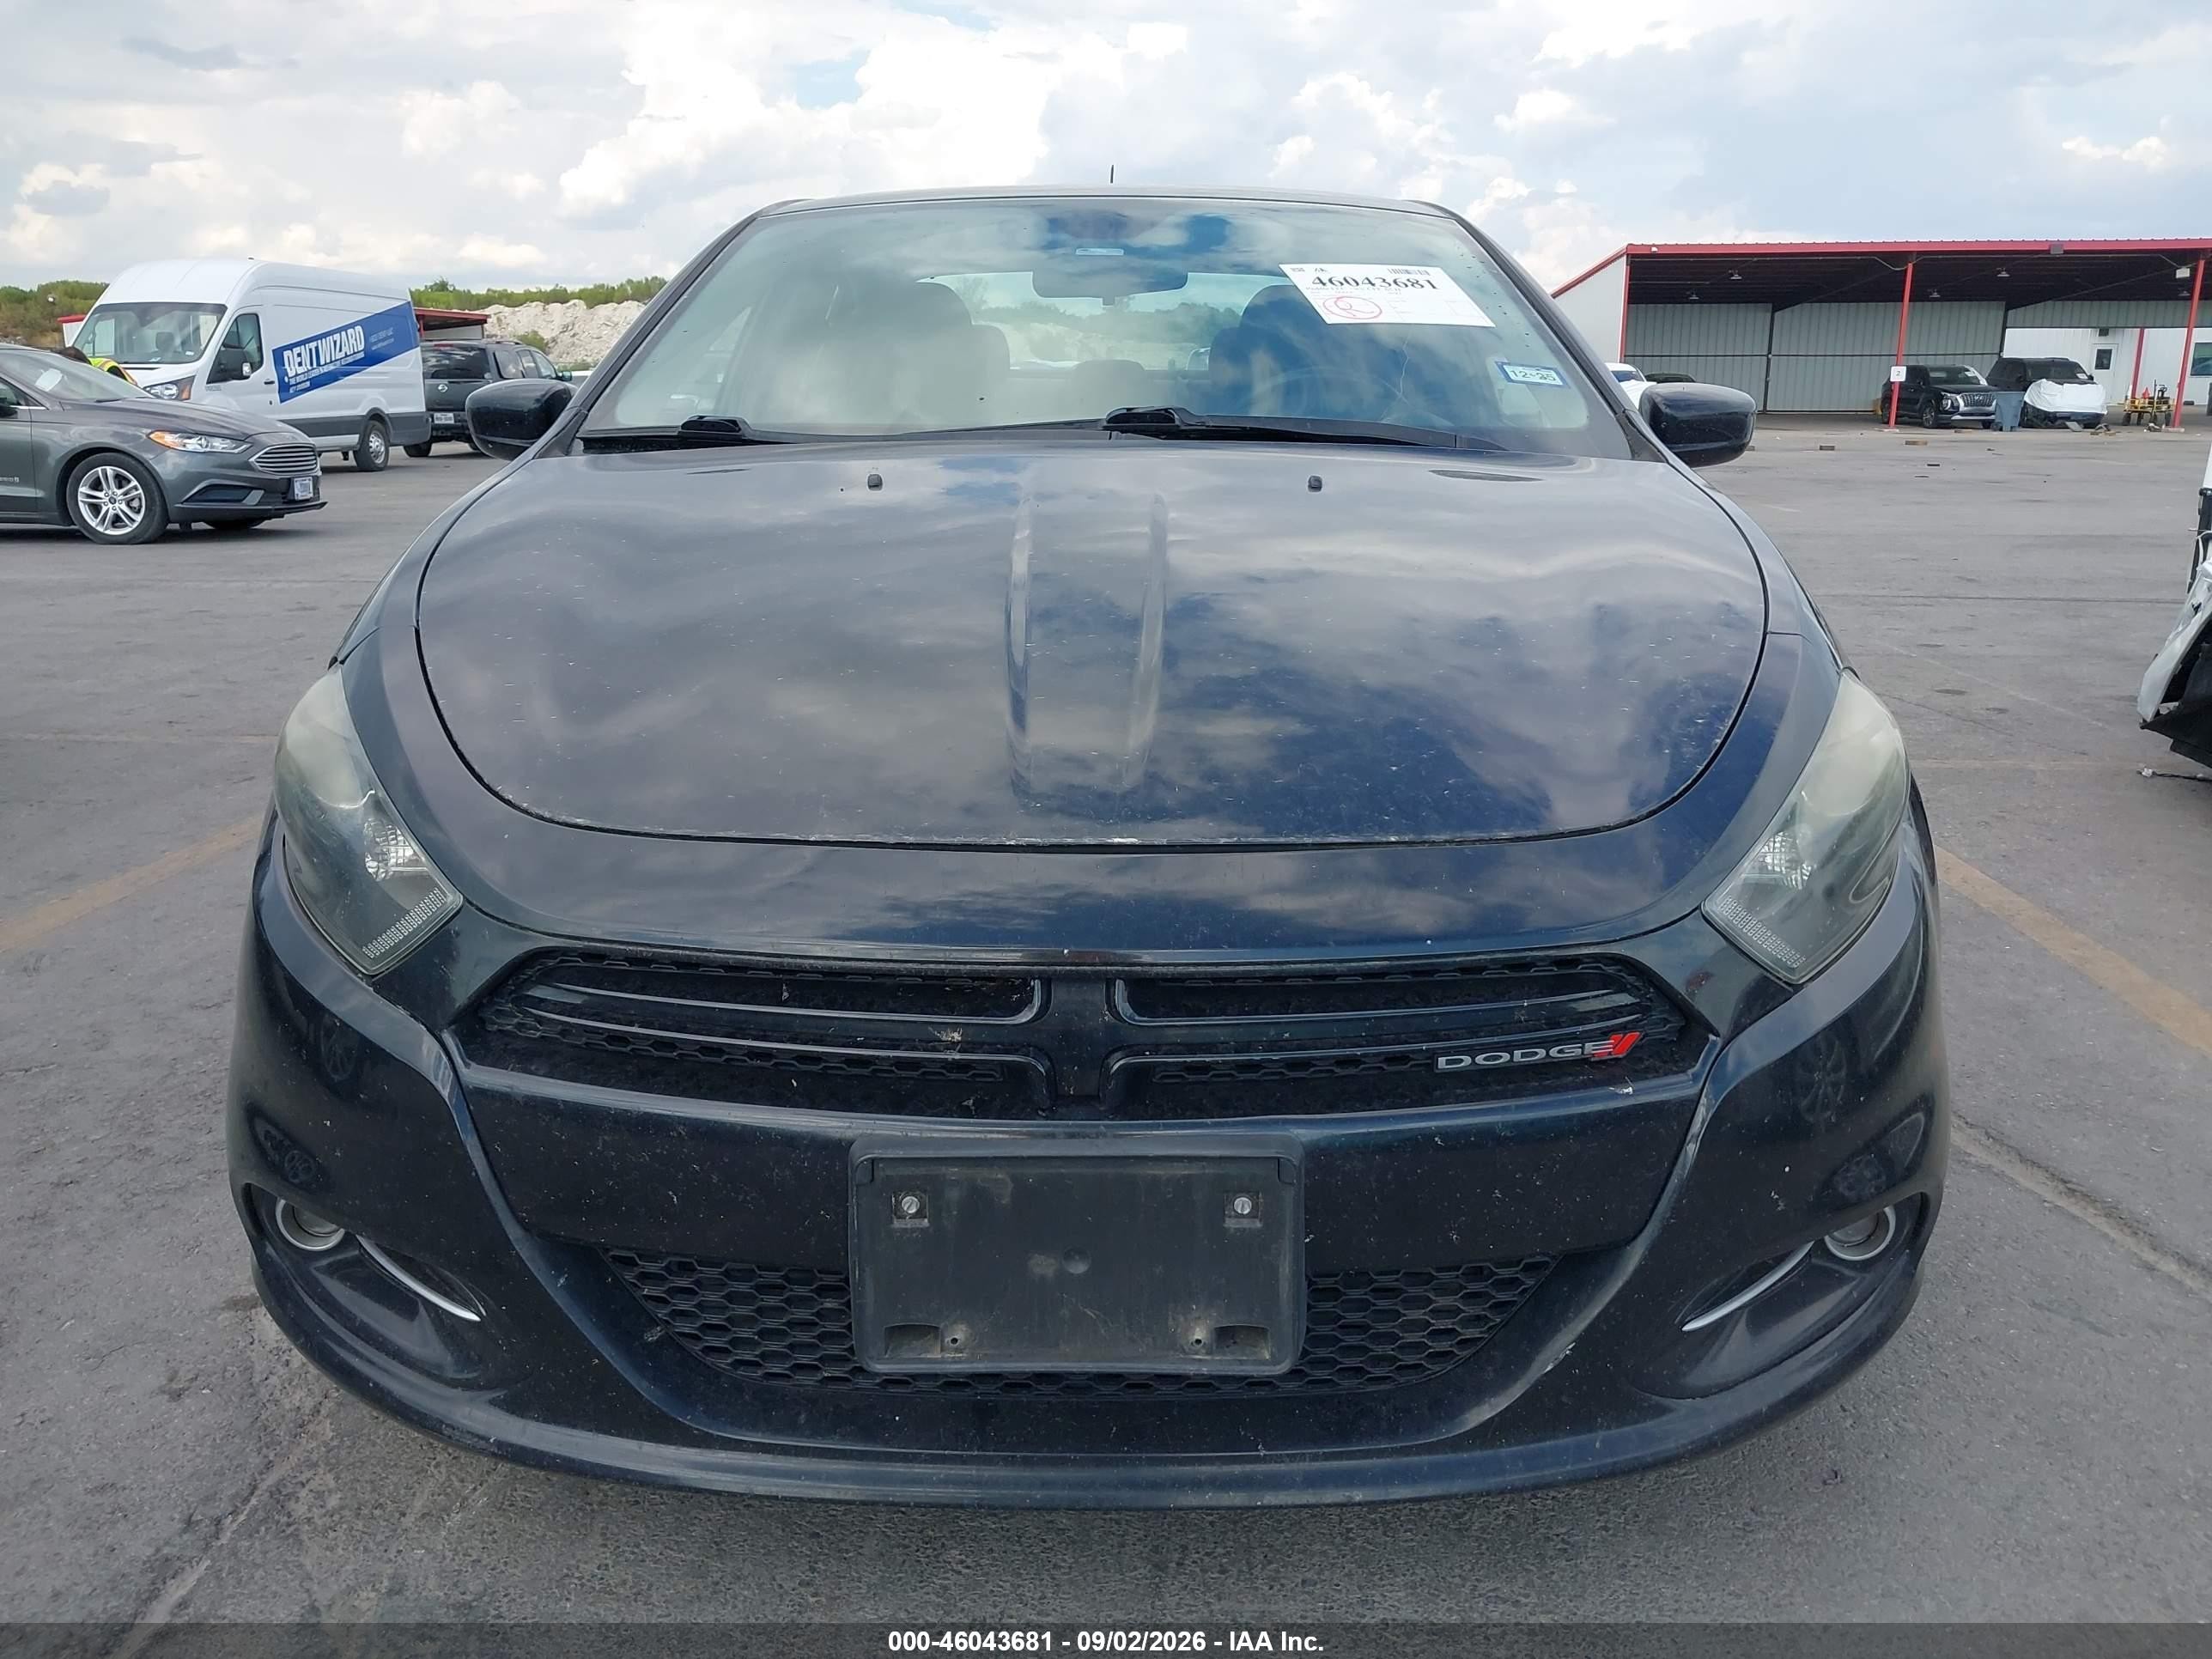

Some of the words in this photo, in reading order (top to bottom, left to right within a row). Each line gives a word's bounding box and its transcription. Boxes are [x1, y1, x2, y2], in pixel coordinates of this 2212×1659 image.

[1311, 276, 1440, 290] 46043681
[283, 342, 317, 377] DENT
[318, 325, 364, 366] WIZARD
[1437, 1040, 1614, 1070] DODGE
